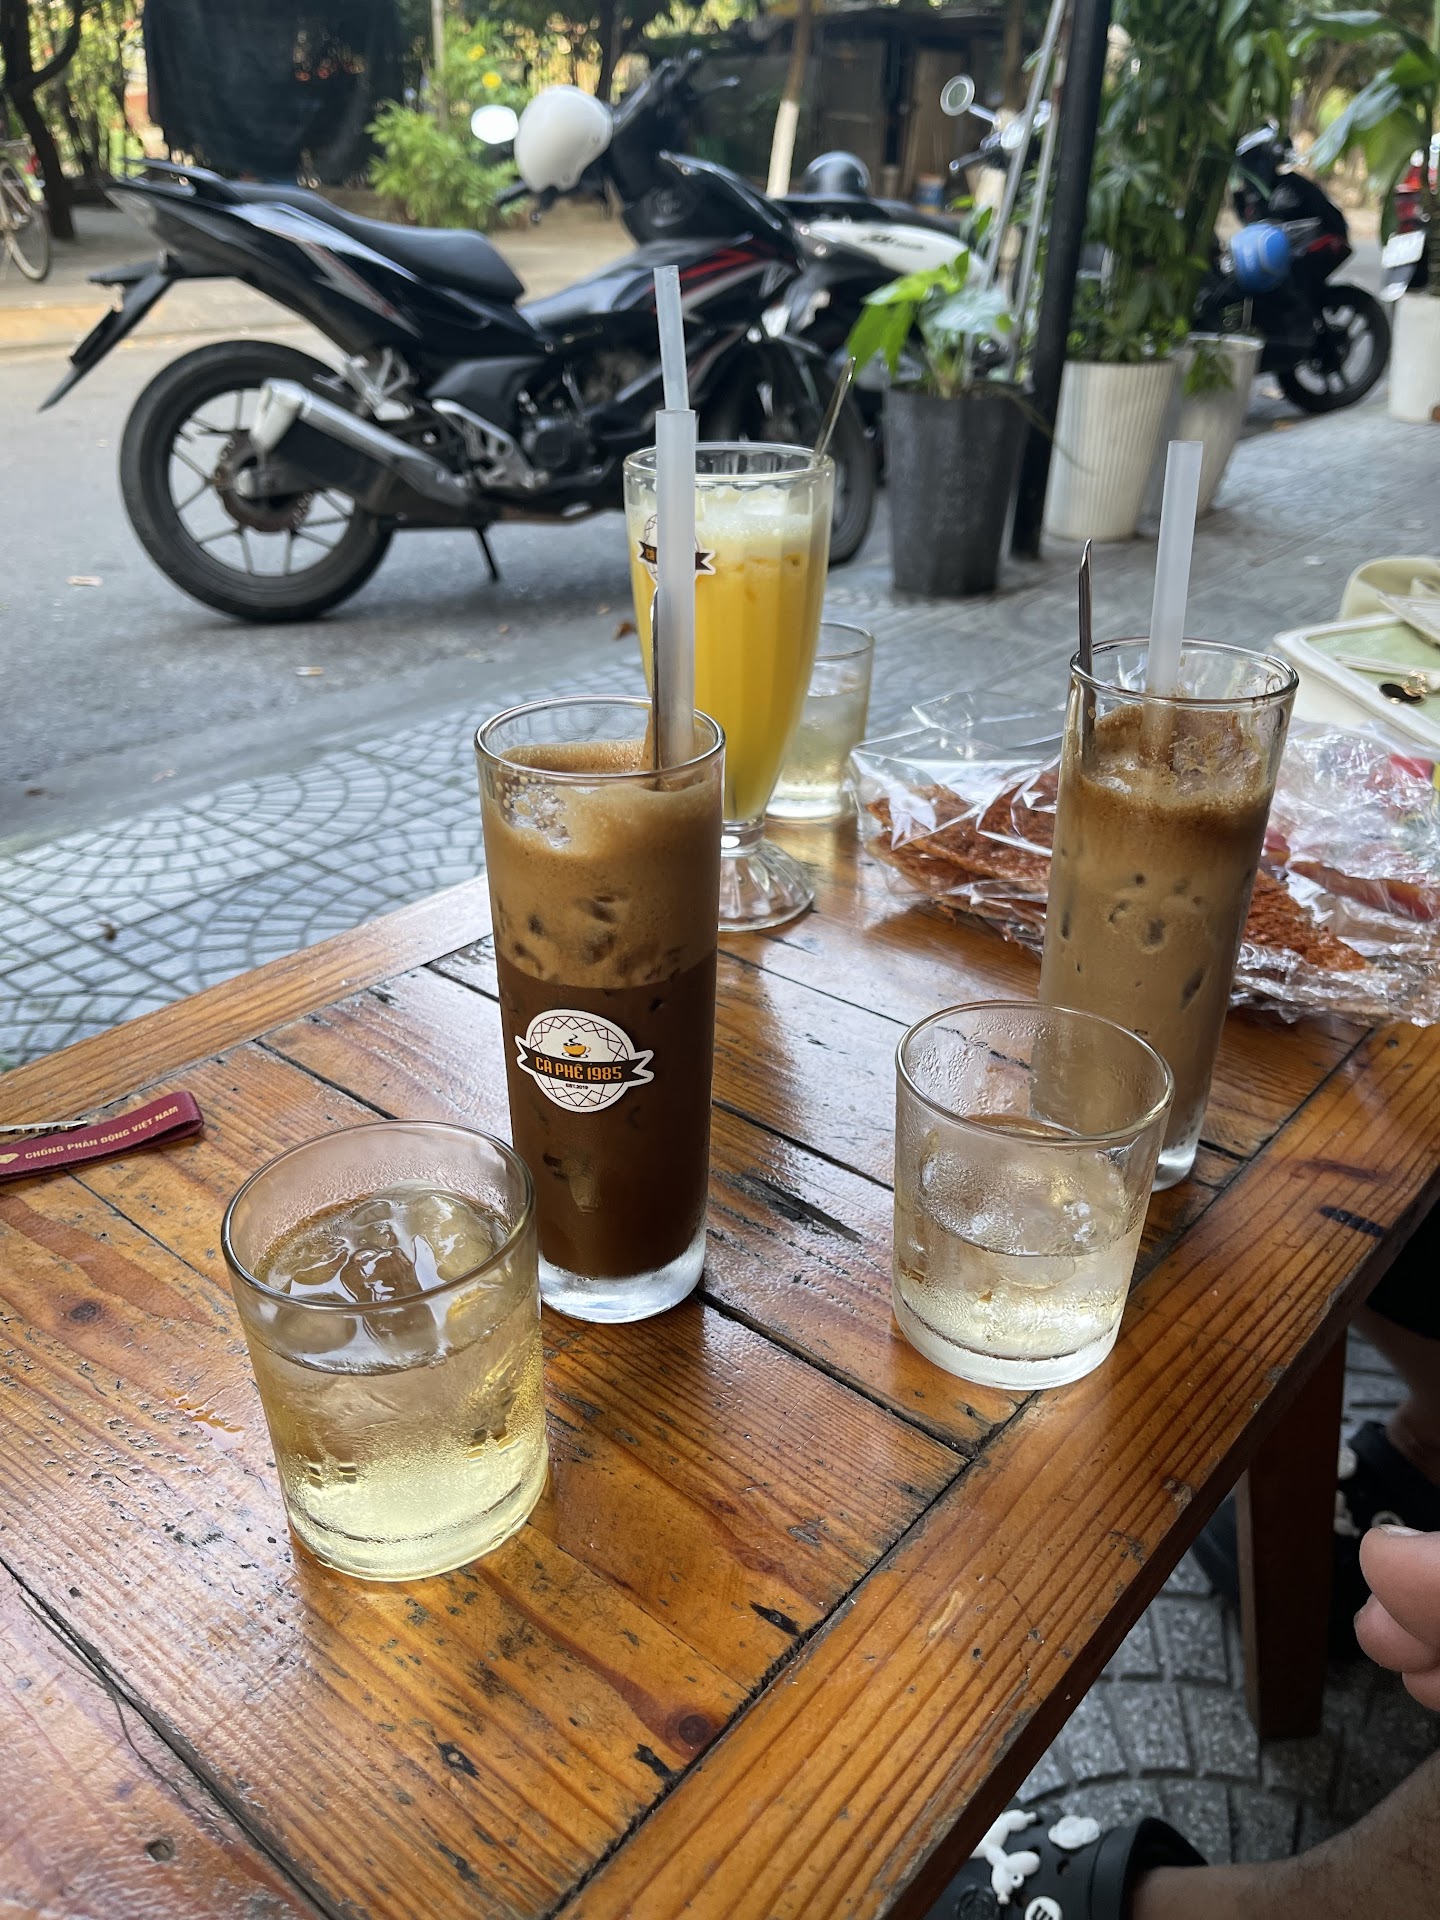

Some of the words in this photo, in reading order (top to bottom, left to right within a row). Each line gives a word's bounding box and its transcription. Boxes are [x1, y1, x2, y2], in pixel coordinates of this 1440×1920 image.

[535, 1056, 553, 1074] CÀ
[555, 1063, 584, 1080] PHÊ
[587, 1066, 622, 1081] 1985
[131, 1118, 153, 1133] VIỆT
[154, 1105, 179, 1122] NAM
